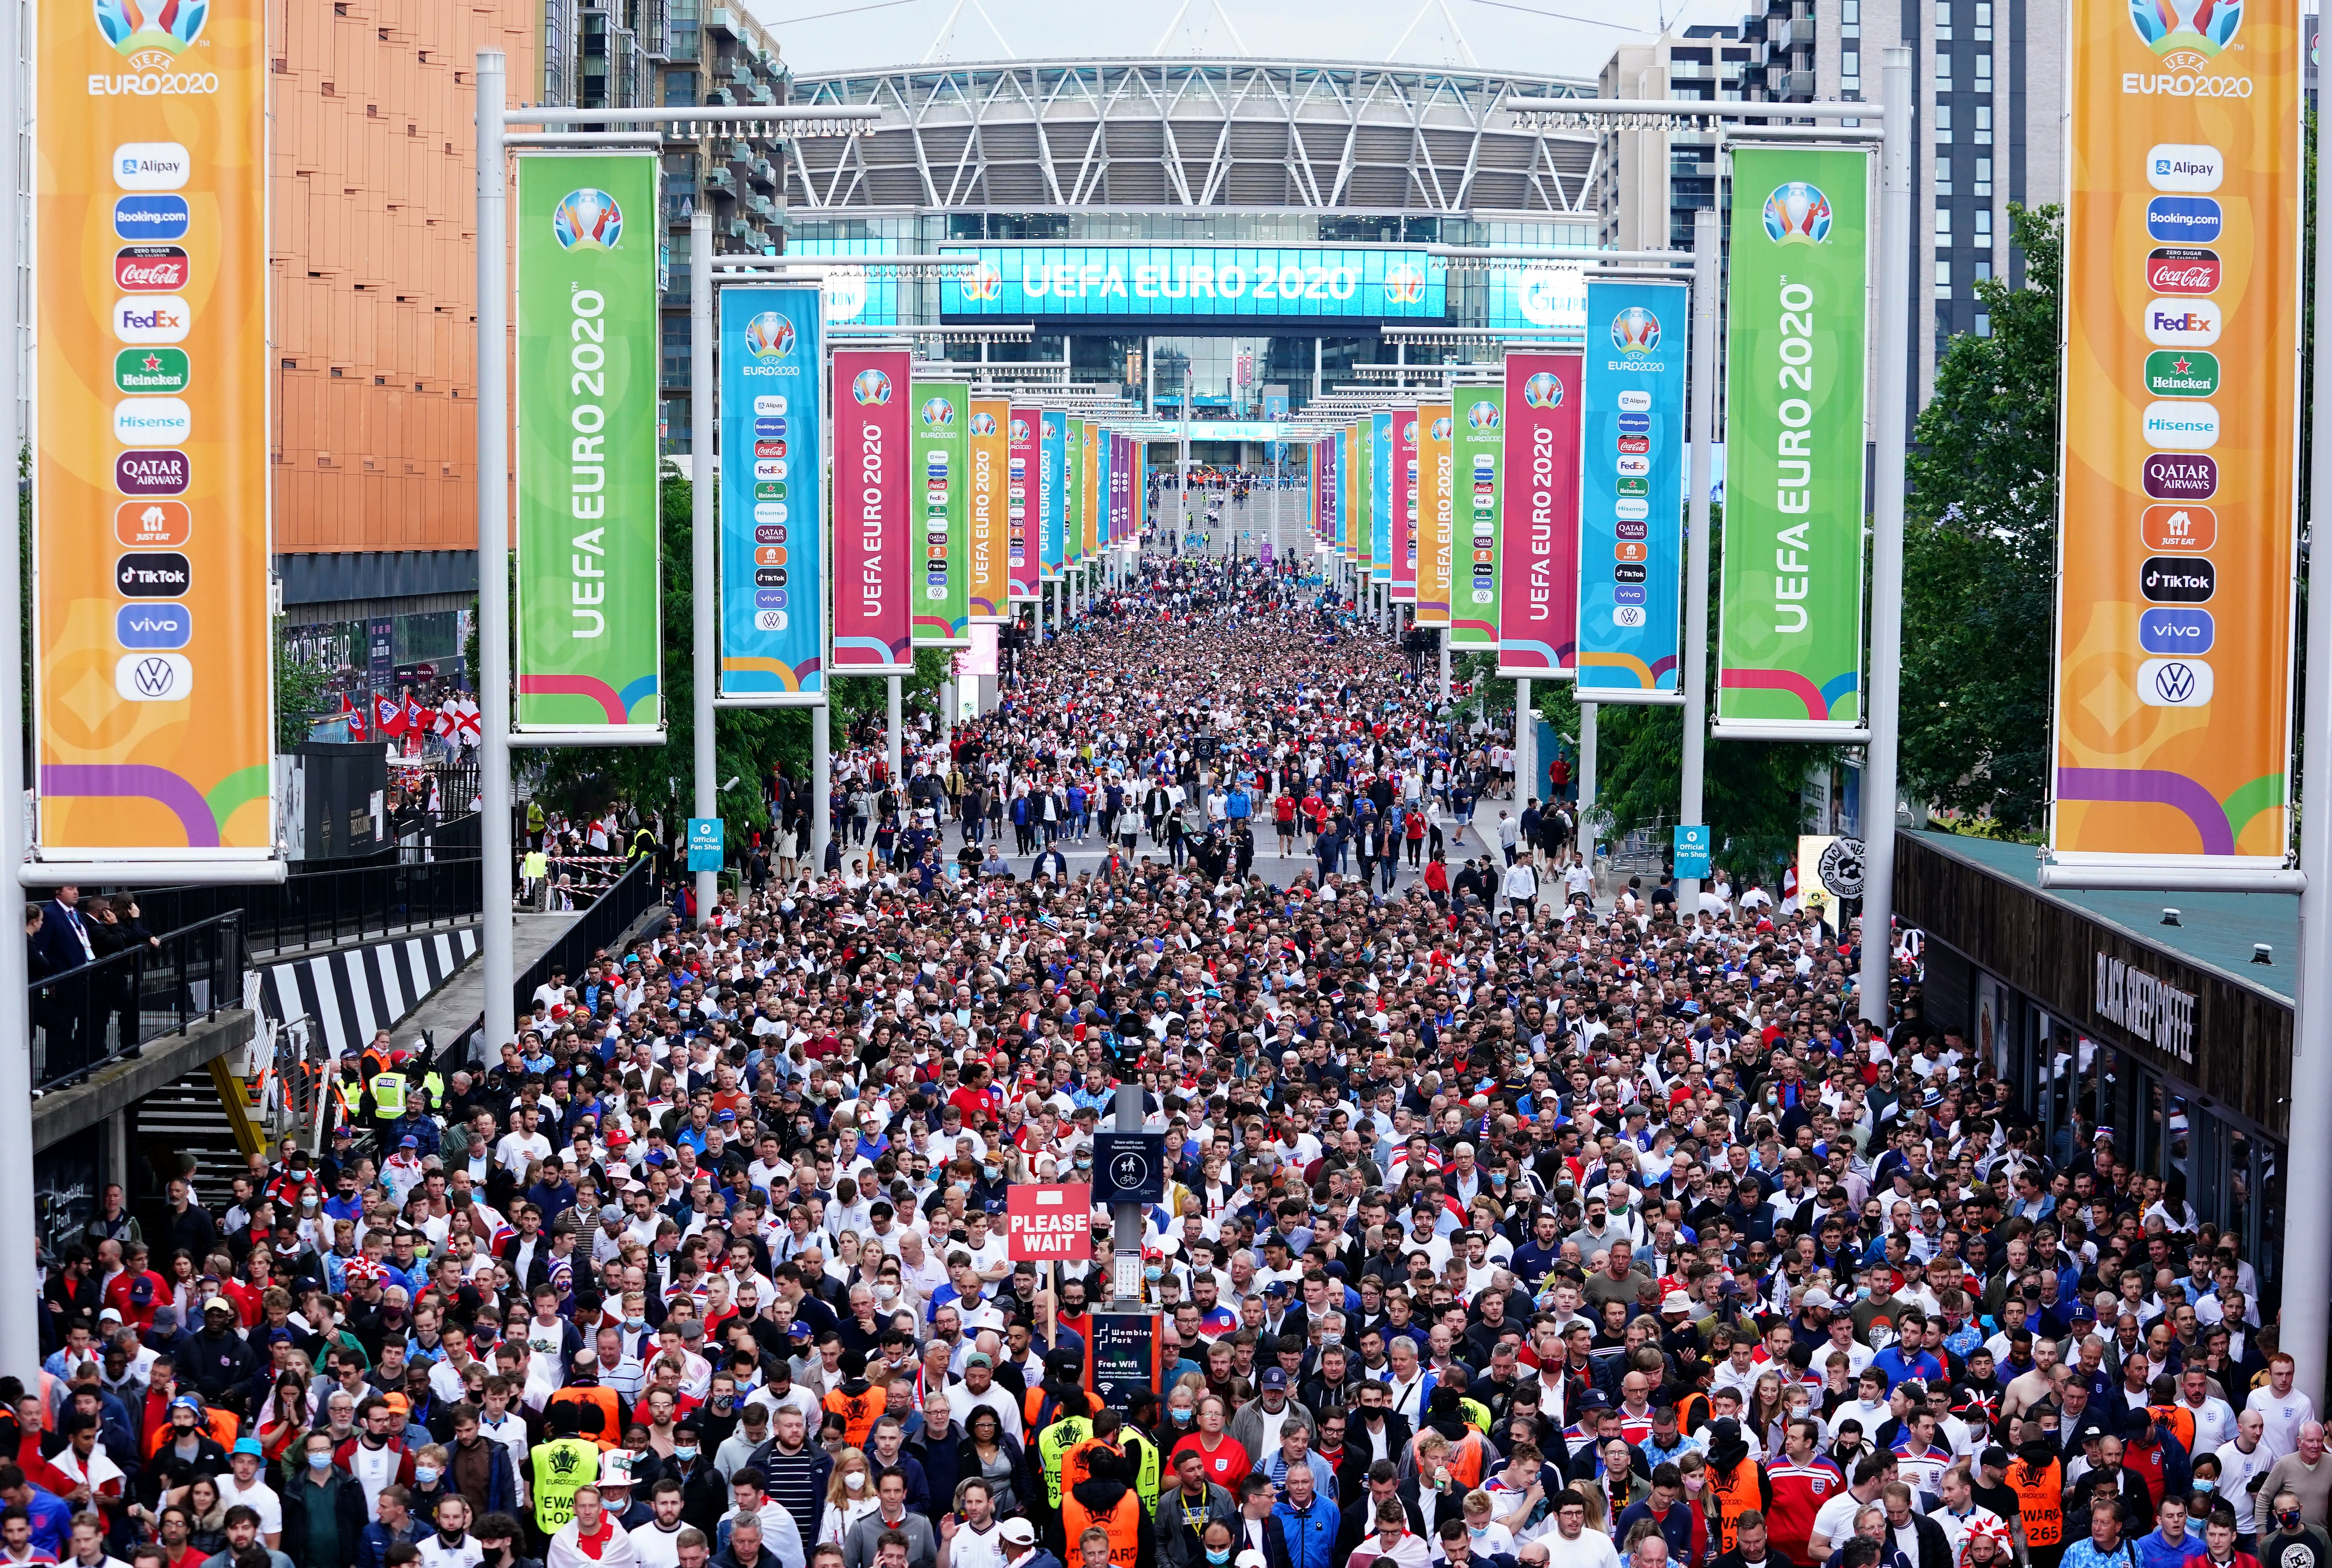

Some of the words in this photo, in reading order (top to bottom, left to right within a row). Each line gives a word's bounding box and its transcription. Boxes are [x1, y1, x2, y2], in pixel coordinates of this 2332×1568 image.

[131, 53, 170, 70] UEFA
[2165, 55, 2204, 71] UEFA
[89, 72, 219, 95] EURO2020
[2123, 73, 2252, 97] EURO2020
[141, 160, 179, 173] Alipay
[2174, 162, 2213, 176] Alipay
[117, 211, 186, 223] Booking.com
[2151, 213, 2218, 226] Booking.com
[121, 264, 181, 284] Coca-Cola
[1022, 265, 1128, 297] UEFA
[1135, 264, 1246, 298] EURO
[1252, 265, 1356, 299] 2020
[2153, 266, 2213, 287] Coca-Cola
[124, 311, 179, 328] FedEx
[2155, 312, 2210, 331] FedEx
[572, 290, 605, 396] 2020
[1779, 284, 1813, 391] 2020
[744, 367, 799, 375] EURO2020
[1608, 361, 1664, 371] EURO2020
[123, 373, 181, 385] Heineken
[2153, 377, 2211, 389] Heineken
[120, 417, 184, 427] Hisense
[2149, 419, 2213, 431] Hisense
[758, 447, 783, 455] Coca-Cola
[863, 424, 881, 484] 2020
[1621, 442, 1646, 451] Coca-Cola
[1778, 399, 1811, 513] EURO
[572, 405, 604, 518] EURO
[1041, 450, 1050, 482] 2020
[1533, 428, 1552, 487] 2020
[122, 460, 182, 476] QATAR
[976, 451, 990, 492] 2020
[1437, 455, 1451, 497] 2020
[2151, 464, 2209, 479] QATAR
[137, 475, 182, 485] AIRWAYS
[2164, 480, 2209, 489] AIRWAYS
[1040, 483, 1050, 517] EURO
[863, 488, 881, 551] EURO
[976, 495, 989, 538] EURO
[1437, 499, 1450, 544] EURO
[1532, 491, 1551, 554] EURO
[1040, 519, 1049, 551] UEFA
[976, 541, 988, 583] UEFA
[1437, 546, 1450, 589] UEFA
[137, 570, 185, 582] TikTok
[572, 527, 604, 638] UEFA
[863, 555, 881, 616] UEFA
[1775, 522, 1809, 632] UEFA
[2162, 575, 2209, 588] TikTok
[1530, 559, 1549, 620] UEFA
[130, 618, 177, 631] vivo
[2153, 623, 2200, 636] vivo
[1824, 845, 1842, 871] BLAC
[2097, 951, 2127, 1031] BLACK
[2126, 965, 2155, 1041] SHEEP
[2155, 981, 2194, 1064] COFFEE
[56, 1183, 84, 1208] Wembley
[57, 1209, 71, 1229] Park
[1011, 1214, 1087, 1233] PLEASE
[1023, 1234, 1074, 1252] WAIT
[2023, 1509, 2060, 1522] WARD
[2029, 1528, 2058, 1541] 265
